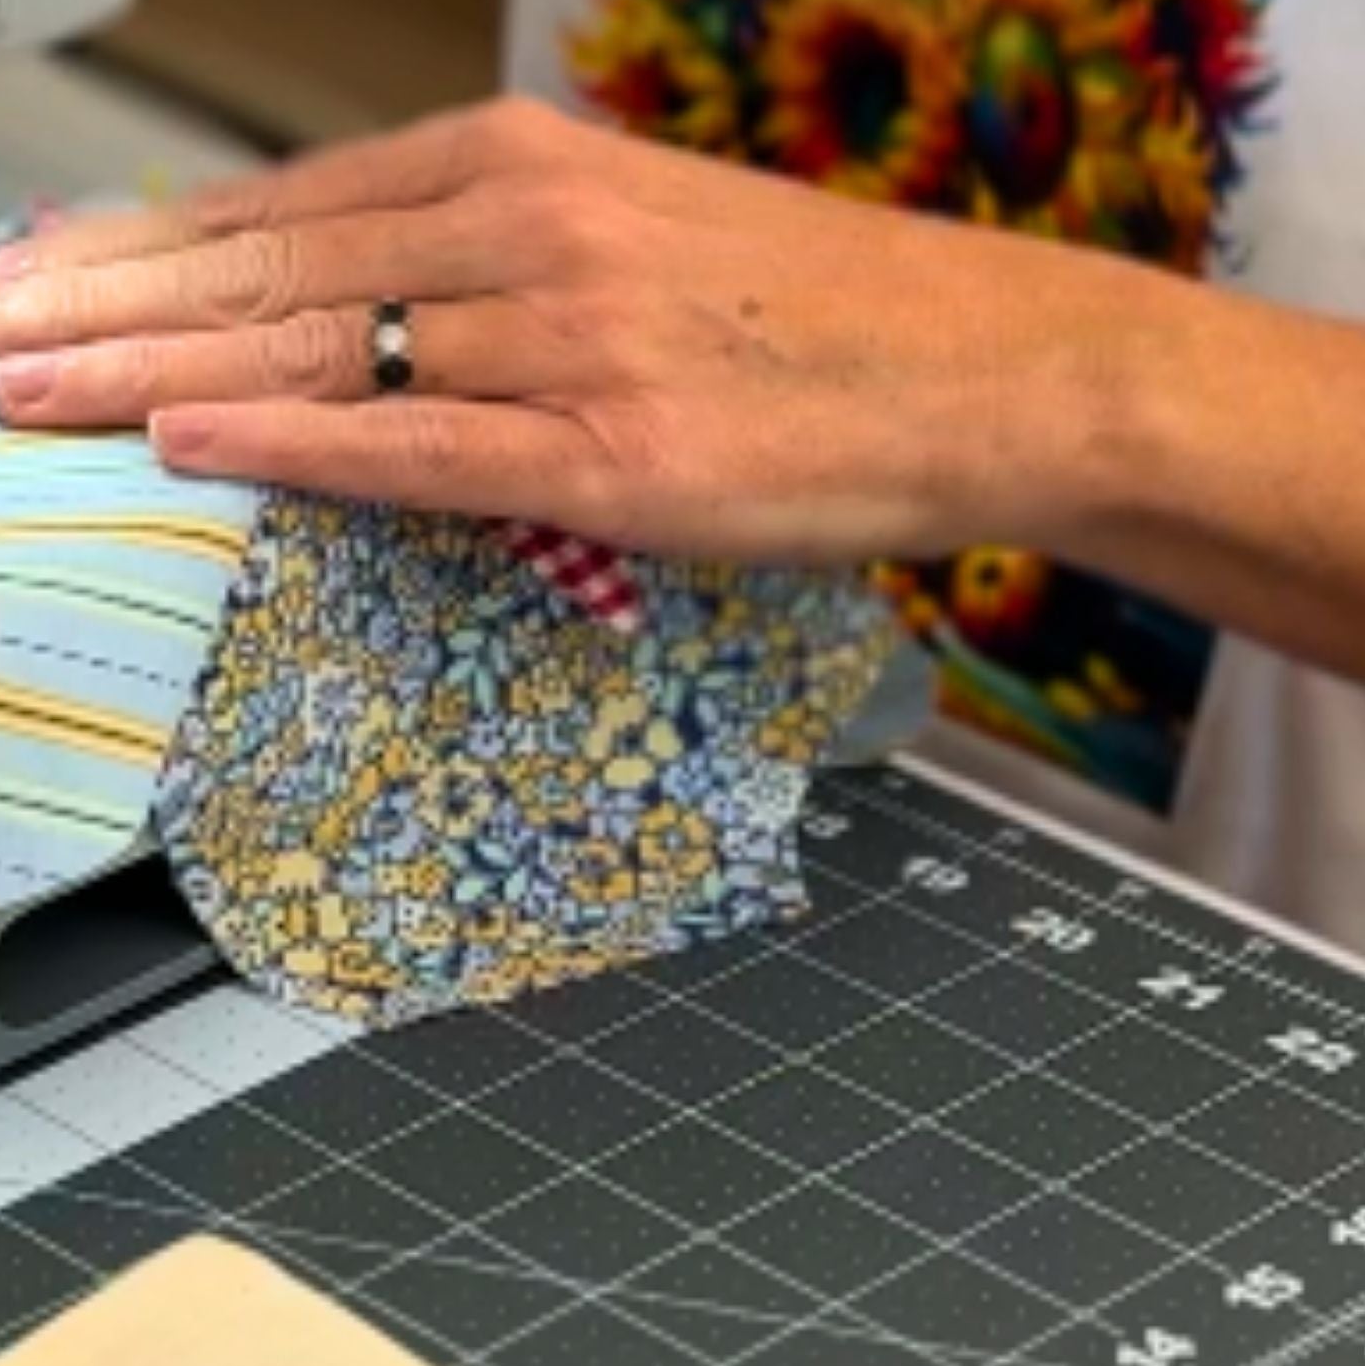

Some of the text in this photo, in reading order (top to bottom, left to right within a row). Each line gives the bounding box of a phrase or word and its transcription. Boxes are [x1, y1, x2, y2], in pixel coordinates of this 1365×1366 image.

[1010, 906, 1095, 953] 20
[1138, 966, 1225, 1010] 21
[1266, 1026, 1355, 1075] 22
[1224, 1263, 1304, 1309] 15
